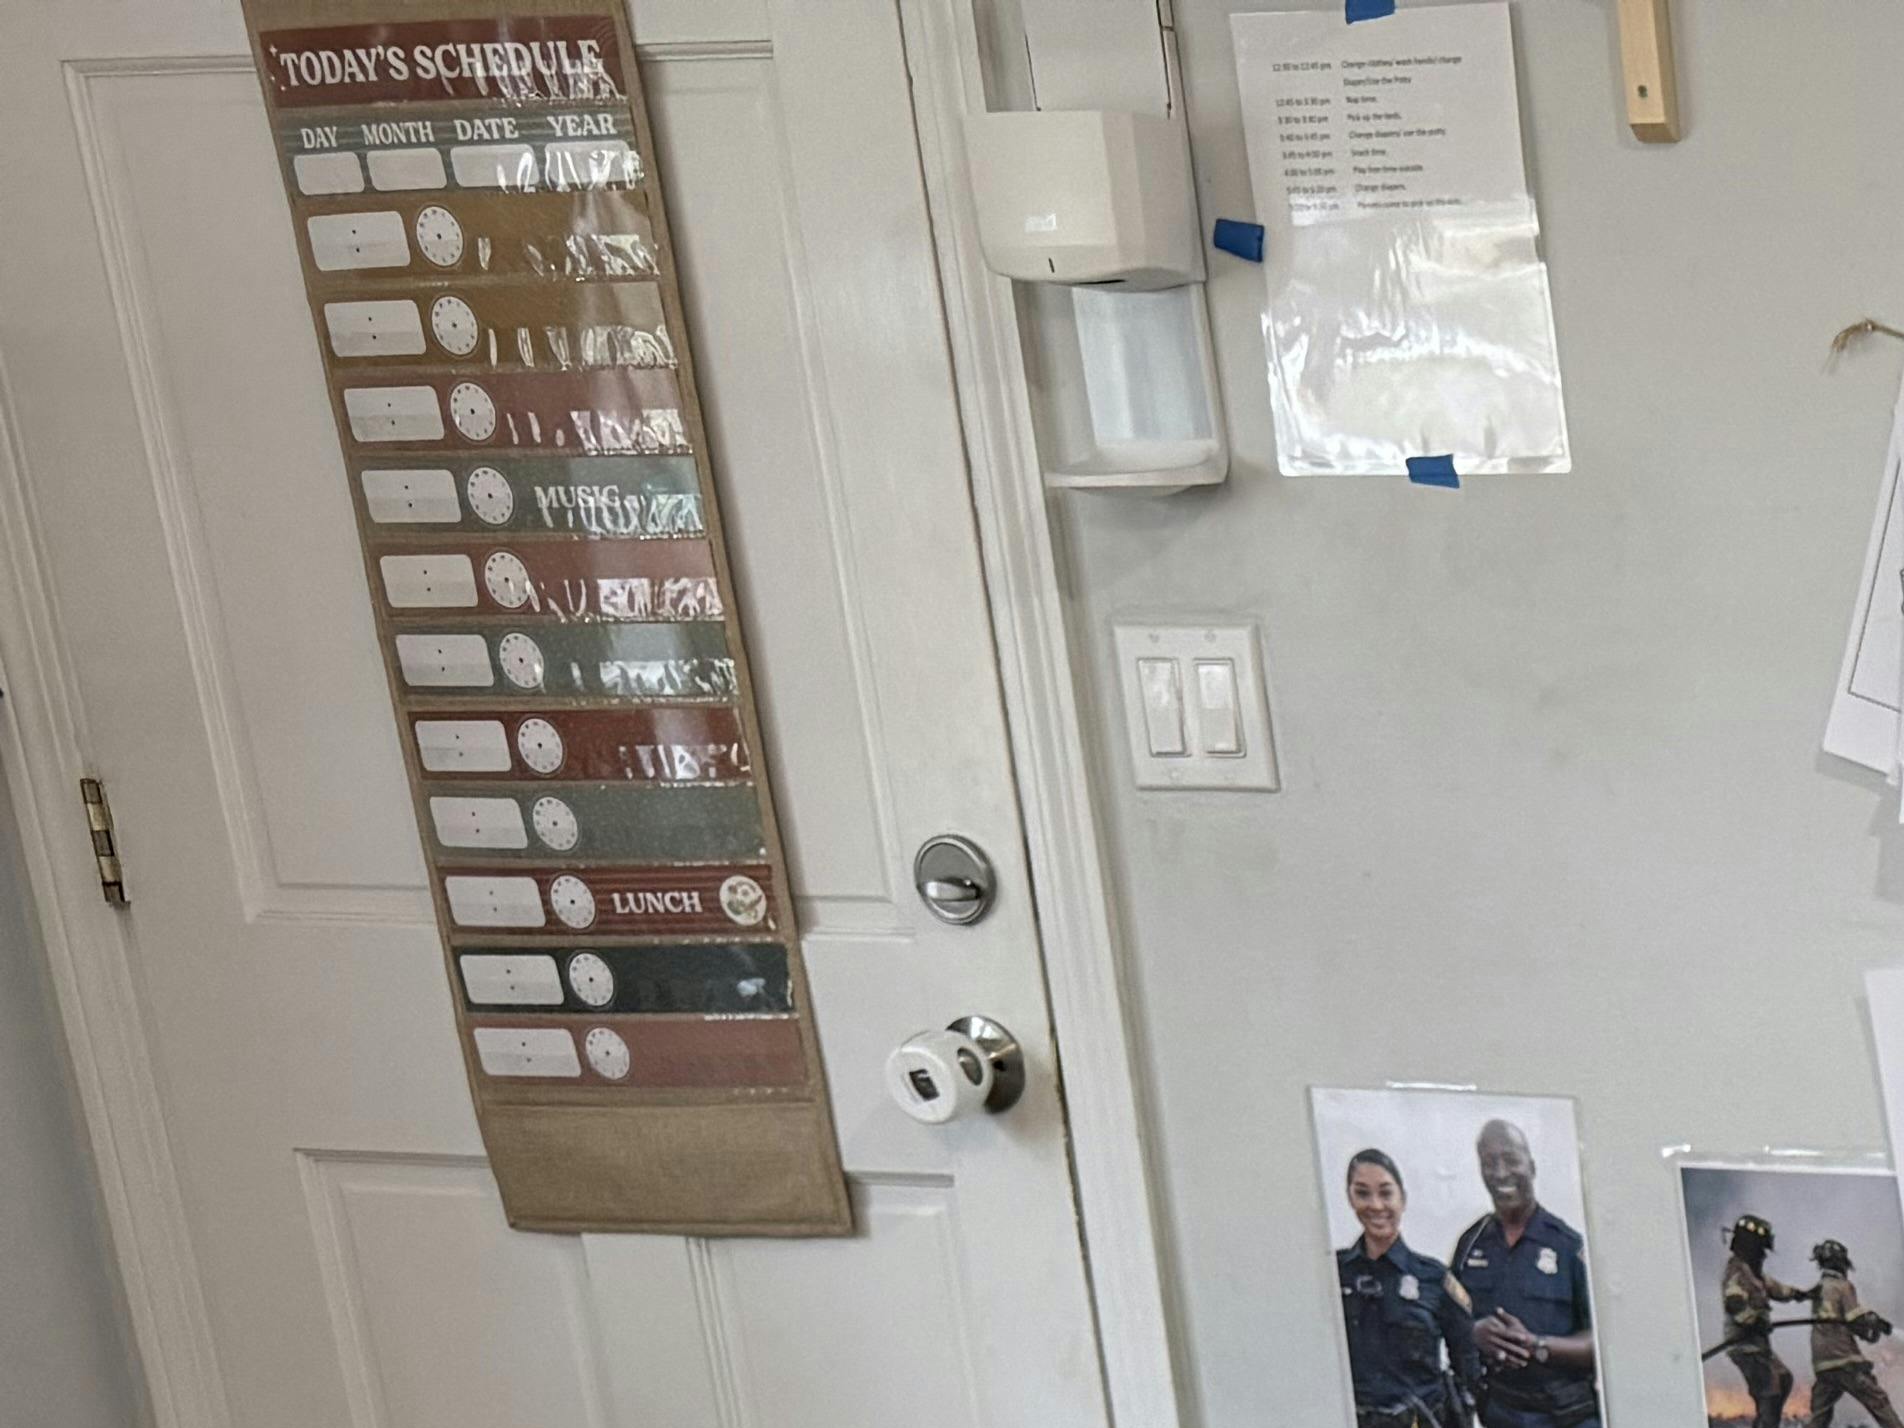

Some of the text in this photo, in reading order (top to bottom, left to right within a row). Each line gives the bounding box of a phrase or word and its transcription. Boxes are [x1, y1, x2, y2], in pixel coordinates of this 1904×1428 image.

[281, 39, 605, 87] TODAY'S SCHEDULE
[301, 113, 618, 149] DAY MONTH DATE YEAR
[533, 484, 620, 510] MUSIC
[611, 890, 704, 914] LUNCH
